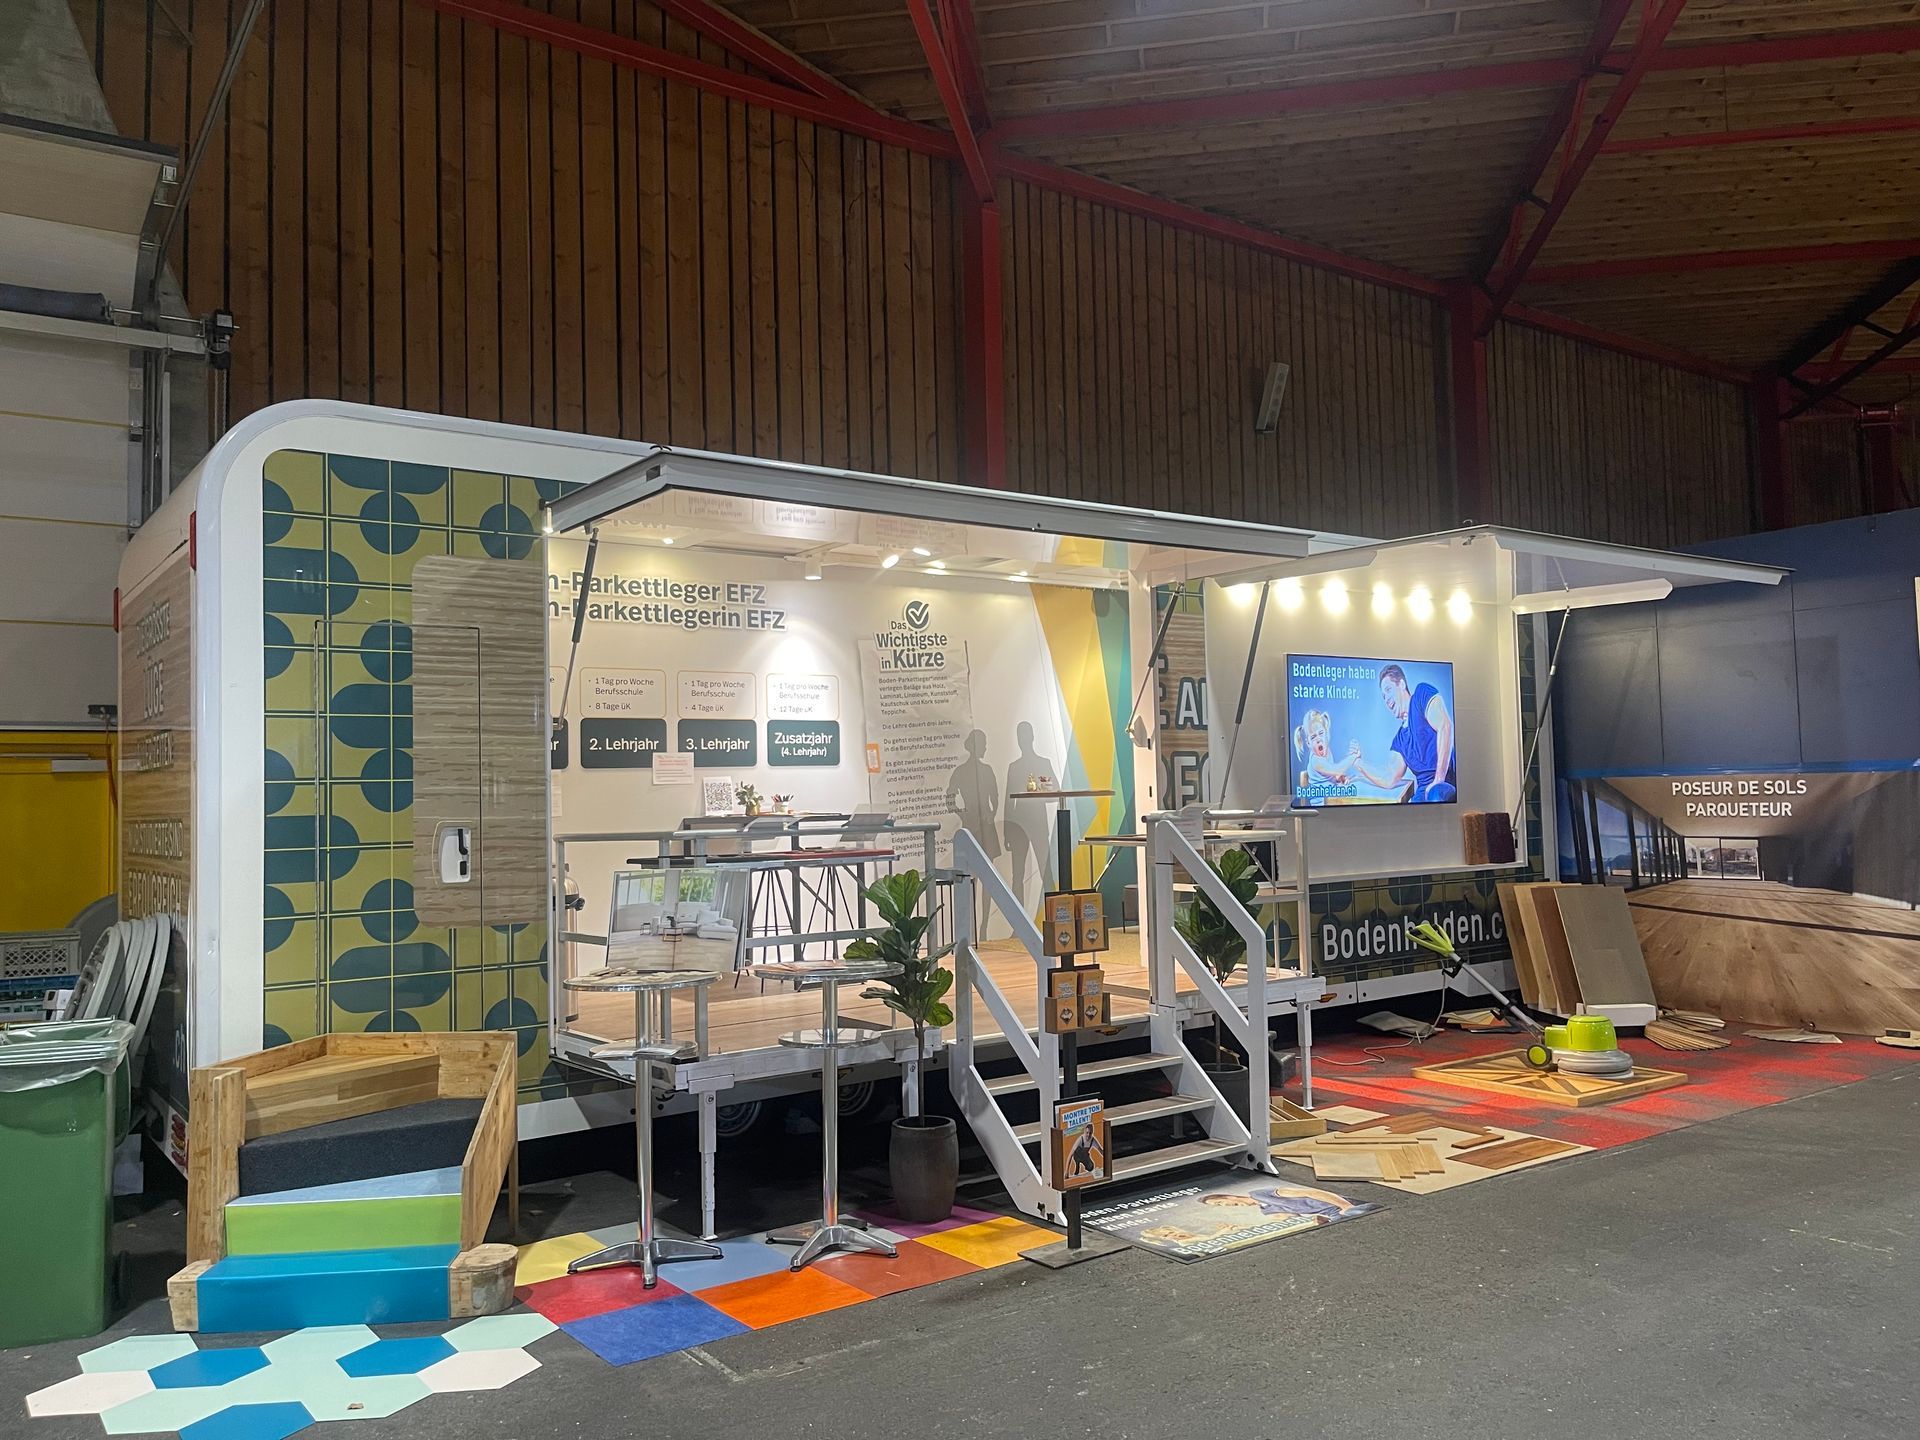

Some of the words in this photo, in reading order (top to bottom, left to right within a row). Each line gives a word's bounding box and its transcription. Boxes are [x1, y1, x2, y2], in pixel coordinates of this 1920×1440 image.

[726, 584, 766, 603] EFZ
[746, 610, 785, 629] EFZ
[890, 620, 907, 630] Das
[876, 632, 947, 650] Wichtigste
[881, 657, 890, 669] in
[893, 648, 945, 668] Kürze
[1293, 663, 1346, 681] Bodenleger
[1349, 666, 1376, 680] haben
[601, 678, 614, 686] Tag
[696, 680, 709, 688] Tag
[1294, 684, 1324, 698] starke
[1327, 685, 1360, 699] Kinder.
[602, 703, 620, 711] Tage
[788, 706, 803, 714] Tage
[589, 739, 602, 750] 2.
[605, 737, 659, 753] Lehrjahr
[686, 739, 699, 750] 3.
[701, 738, 750, 752] Lehrjahr
[774, 732, 832, 746] Zusatzjahr
[781, 747, 791, 756] (4.
[793, 747, 827, 757] Lehrjahr)
[1296, 784, 1357, 798] Bodenhelden.ch
[1672, 780, 1733, 796] POSEUR
[1738, 781, 1759, 795] DE
[1763, 780, 1807, 795] SOLS
[1686, 802, 1792, 817] PARQUETEUR
[1323, 910, 1503, 961] Bodenhden.c
[1064, 1109, 1088, 1120] MONTRE
[1089, 1105, 1100, 1113] TON
[1084, 1212, 1134, 1226] haben
[1132, 1202, 1179, 1215] starke
[1174, 1216, 1312, 1255] Bodenhelden.ch
